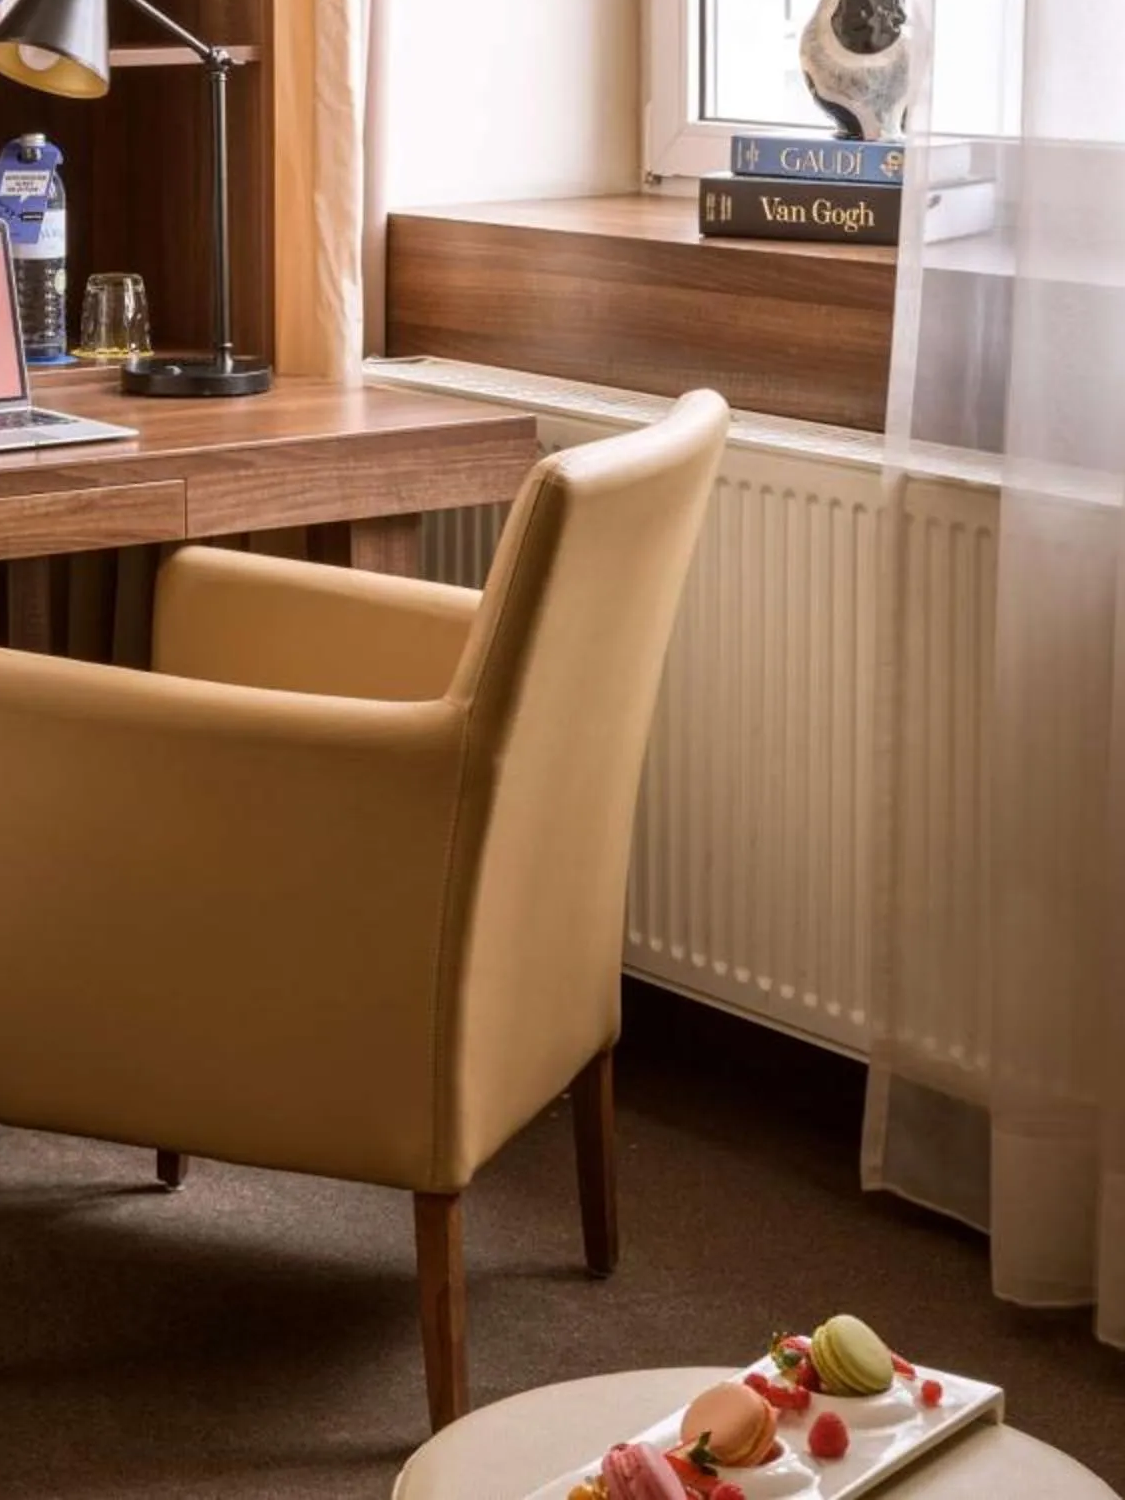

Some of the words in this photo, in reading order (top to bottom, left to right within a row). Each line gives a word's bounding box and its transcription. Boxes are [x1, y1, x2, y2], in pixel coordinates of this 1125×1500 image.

[780, 146, 864, 177] GAUDÍ
[761, 195, 806, 223] Van
[812, 198, 875, 233] Gogh
